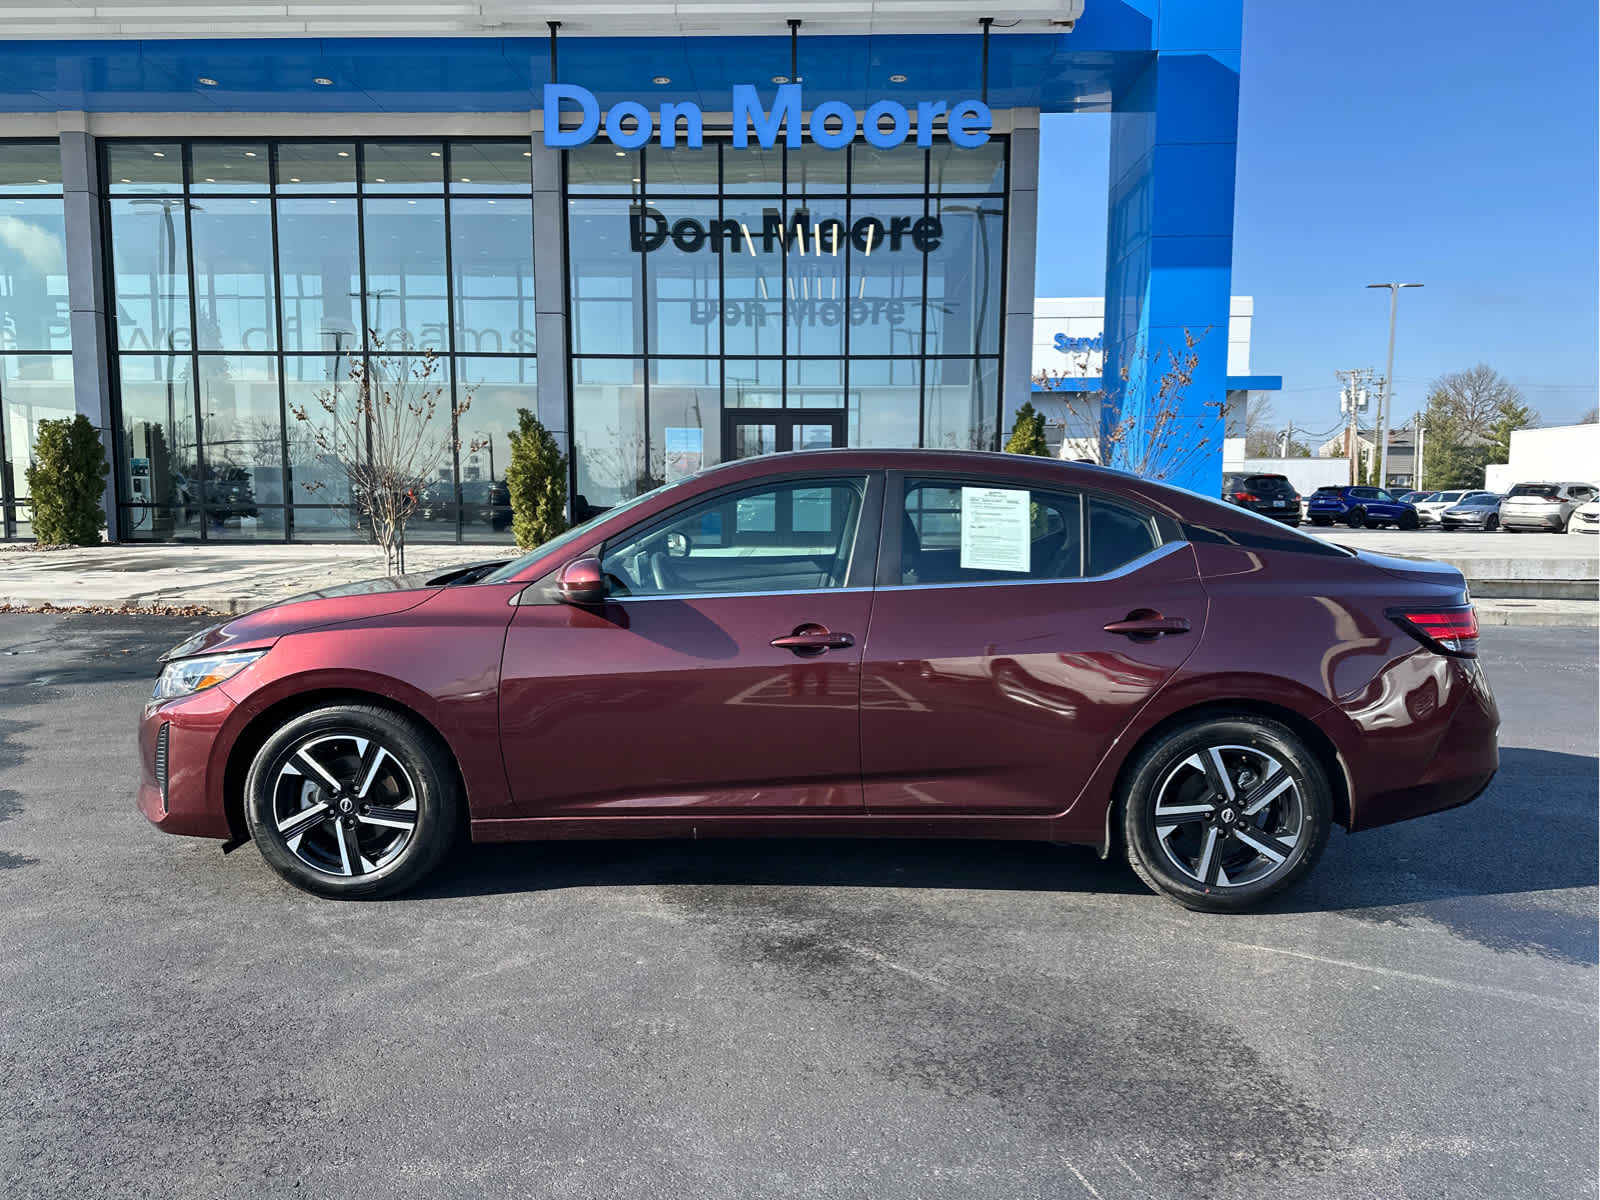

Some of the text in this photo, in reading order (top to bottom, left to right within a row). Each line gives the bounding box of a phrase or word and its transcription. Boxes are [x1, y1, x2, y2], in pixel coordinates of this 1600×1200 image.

[543, 83, 993, 150] Don Moore
[629, 204, 943, 253] Don Moore
